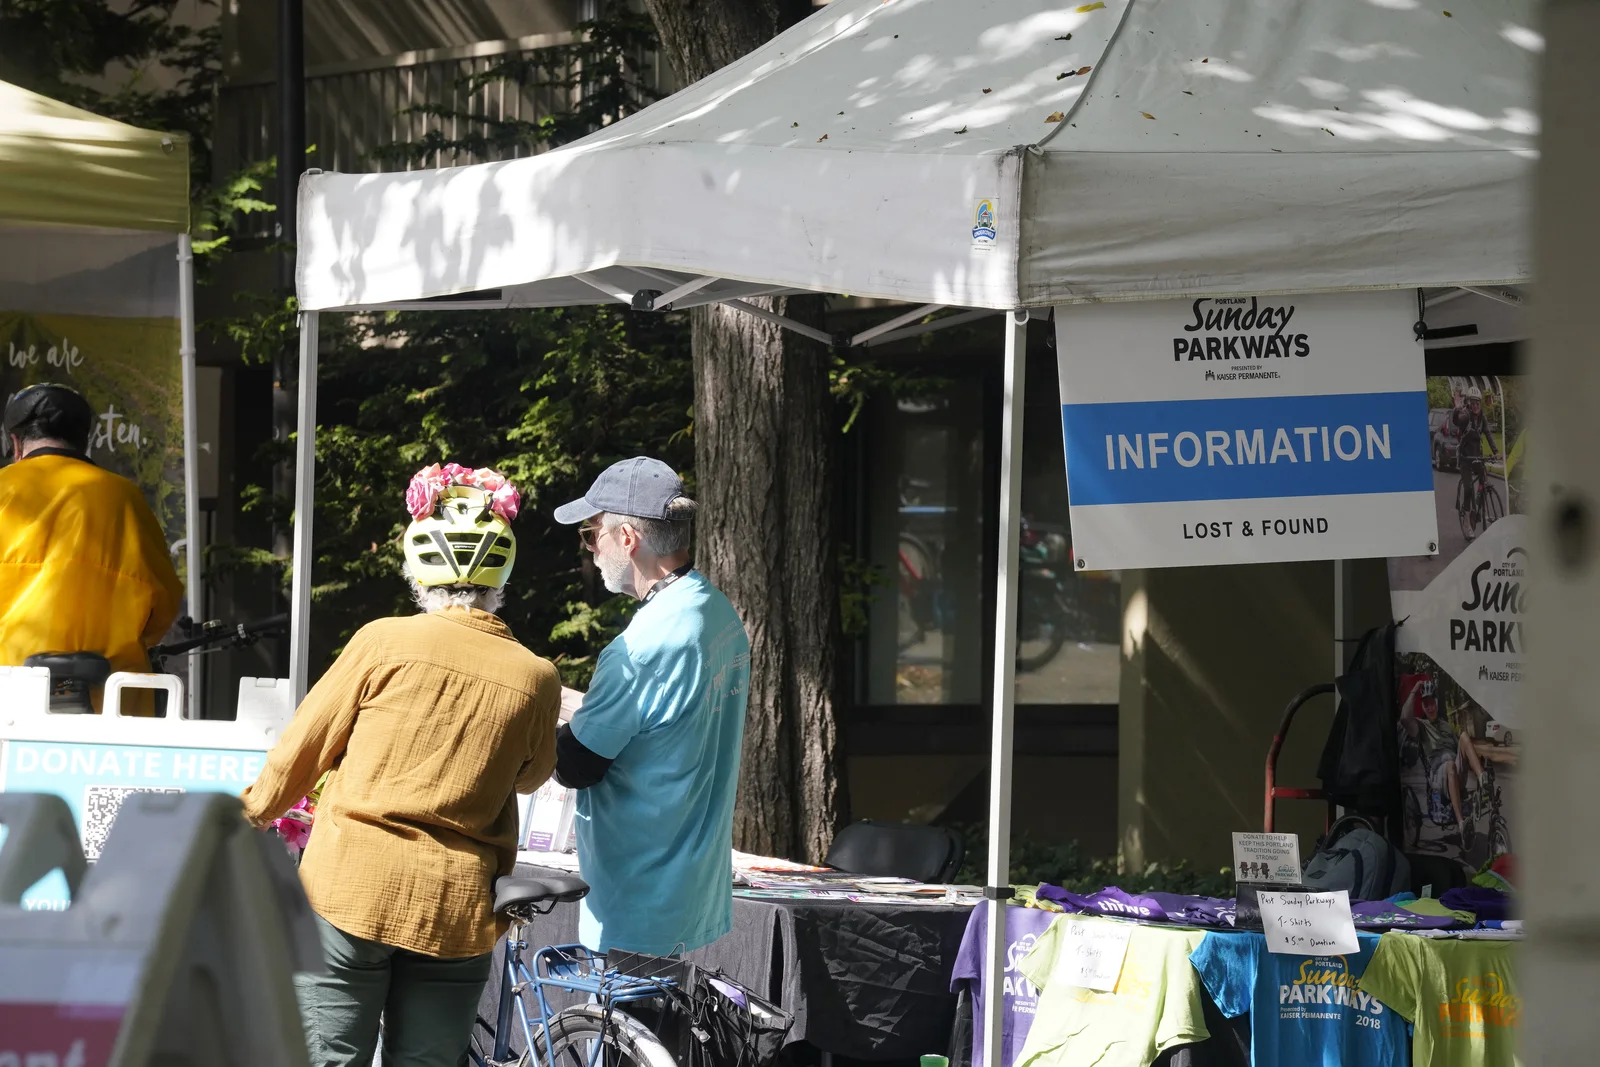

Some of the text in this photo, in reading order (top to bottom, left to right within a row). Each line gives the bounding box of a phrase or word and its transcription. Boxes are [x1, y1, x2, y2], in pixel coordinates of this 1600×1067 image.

[1184, 296, 1295, 339] Sunday
[9, 337, 84, 374] we are
[1173, 333, 1310, 361] PARKWAYS
[1238, 372, 1279, 380] PERMANENTE
[1105, 424, 1391, 470] INFORMATION
[1183, 517, 1329, 539] LOST & FOUND
[1489, 672, 1509, 681] KAISER
[15, 747, 261, 782] DONATE HERE
[1260, 893, 1335, 908] Past Sunday Parkways
[1310, 938, 1336, 947] Donation
[1356, 1015, 1381, 1029] 2018
